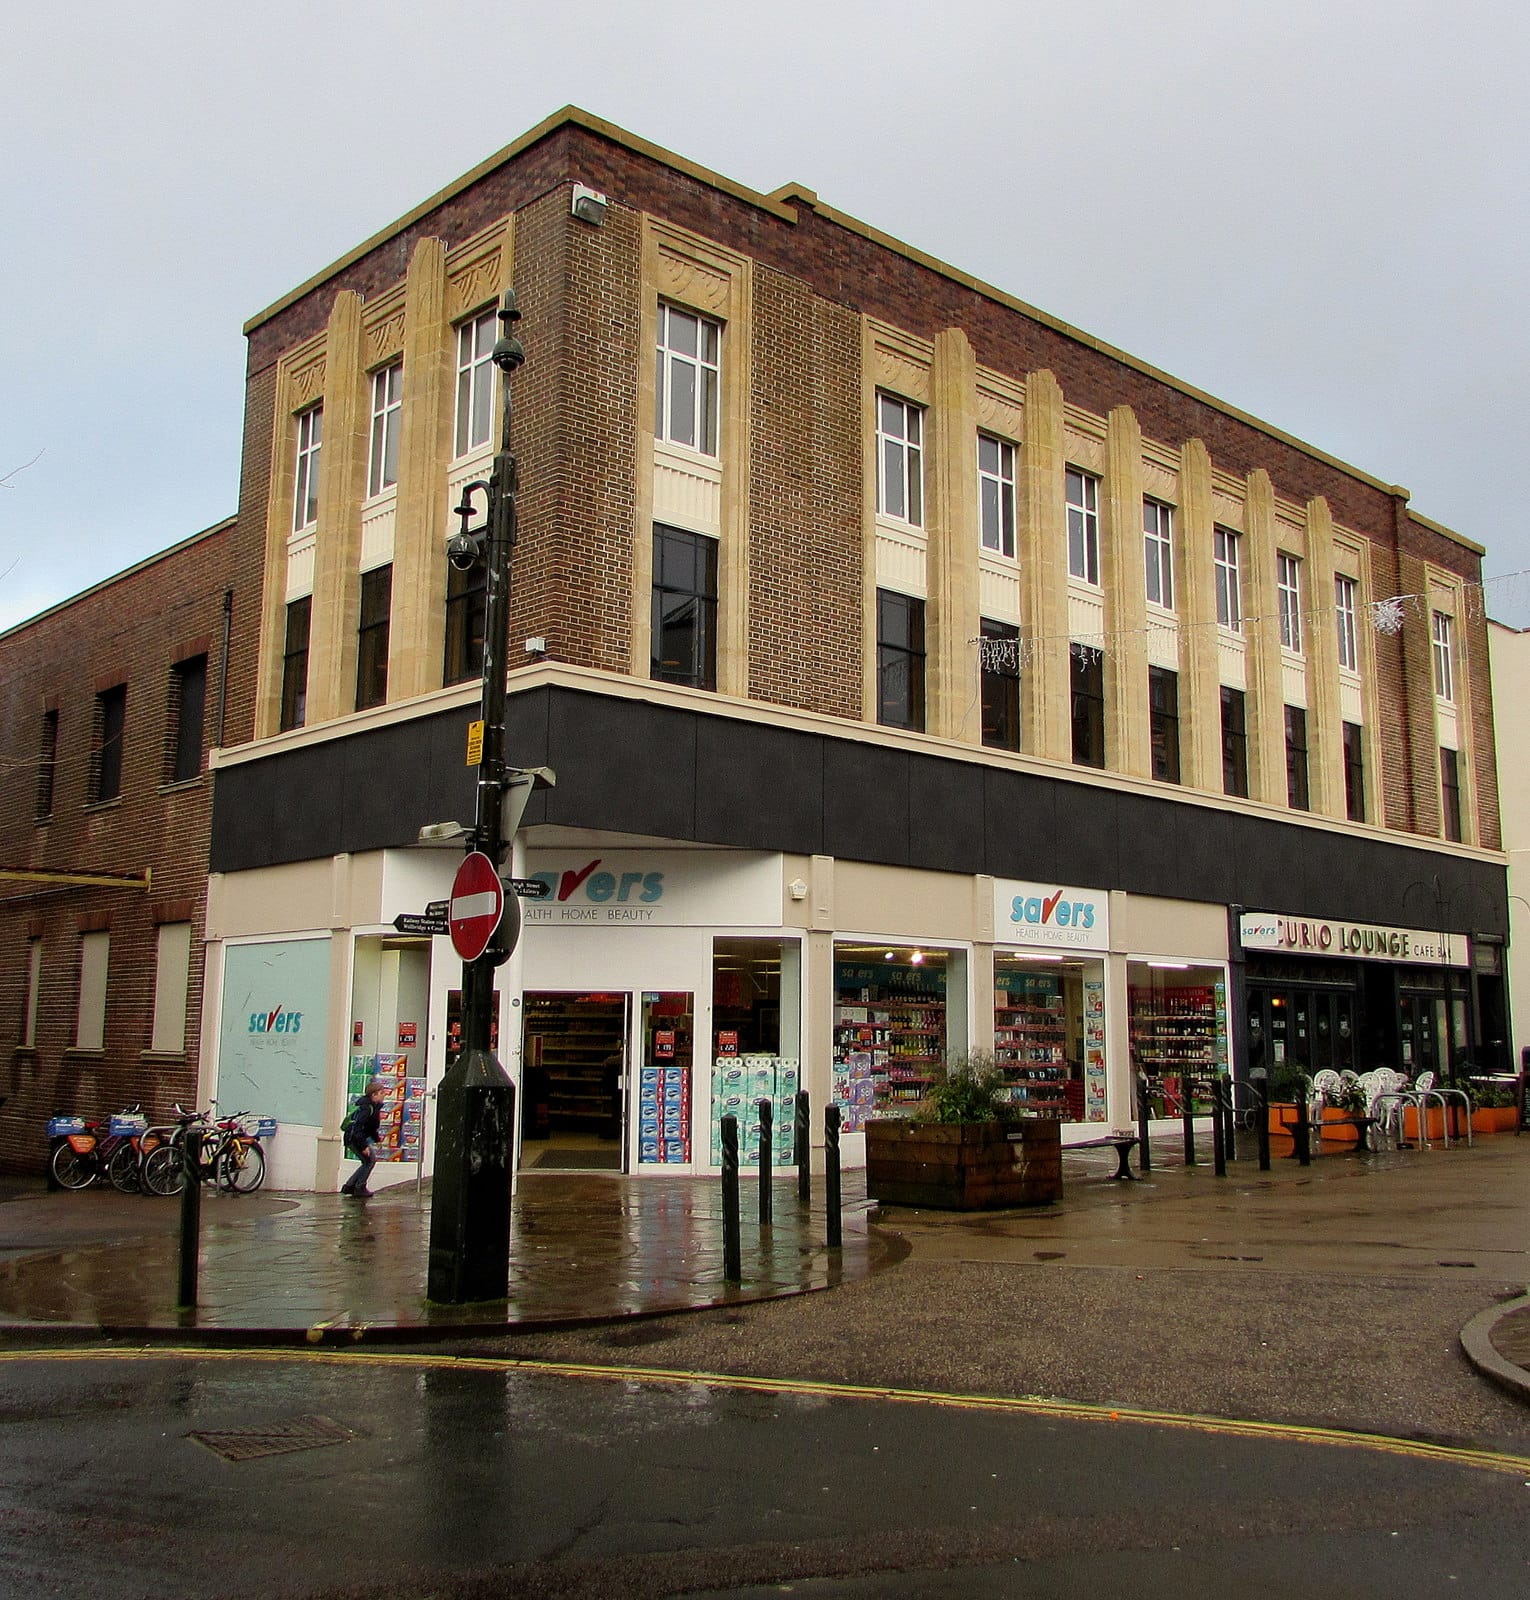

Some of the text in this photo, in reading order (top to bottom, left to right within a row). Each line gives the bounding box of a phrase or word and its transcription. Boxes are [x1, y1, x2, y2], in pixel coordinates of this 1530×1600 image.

[526, 858, 665, 903] avers
[524, 908, 654, 921] ALTH HOME BEAUTY
[1010, 889, 1095, 929] savers
[1015, 928, 1090, 943] HEALTH HOME BEAUTY
[1242, 924, 1277, 935] savers
[1339, 926, 1410, 955] LOUNGE
[248, 1004, 302, 1033] savers
